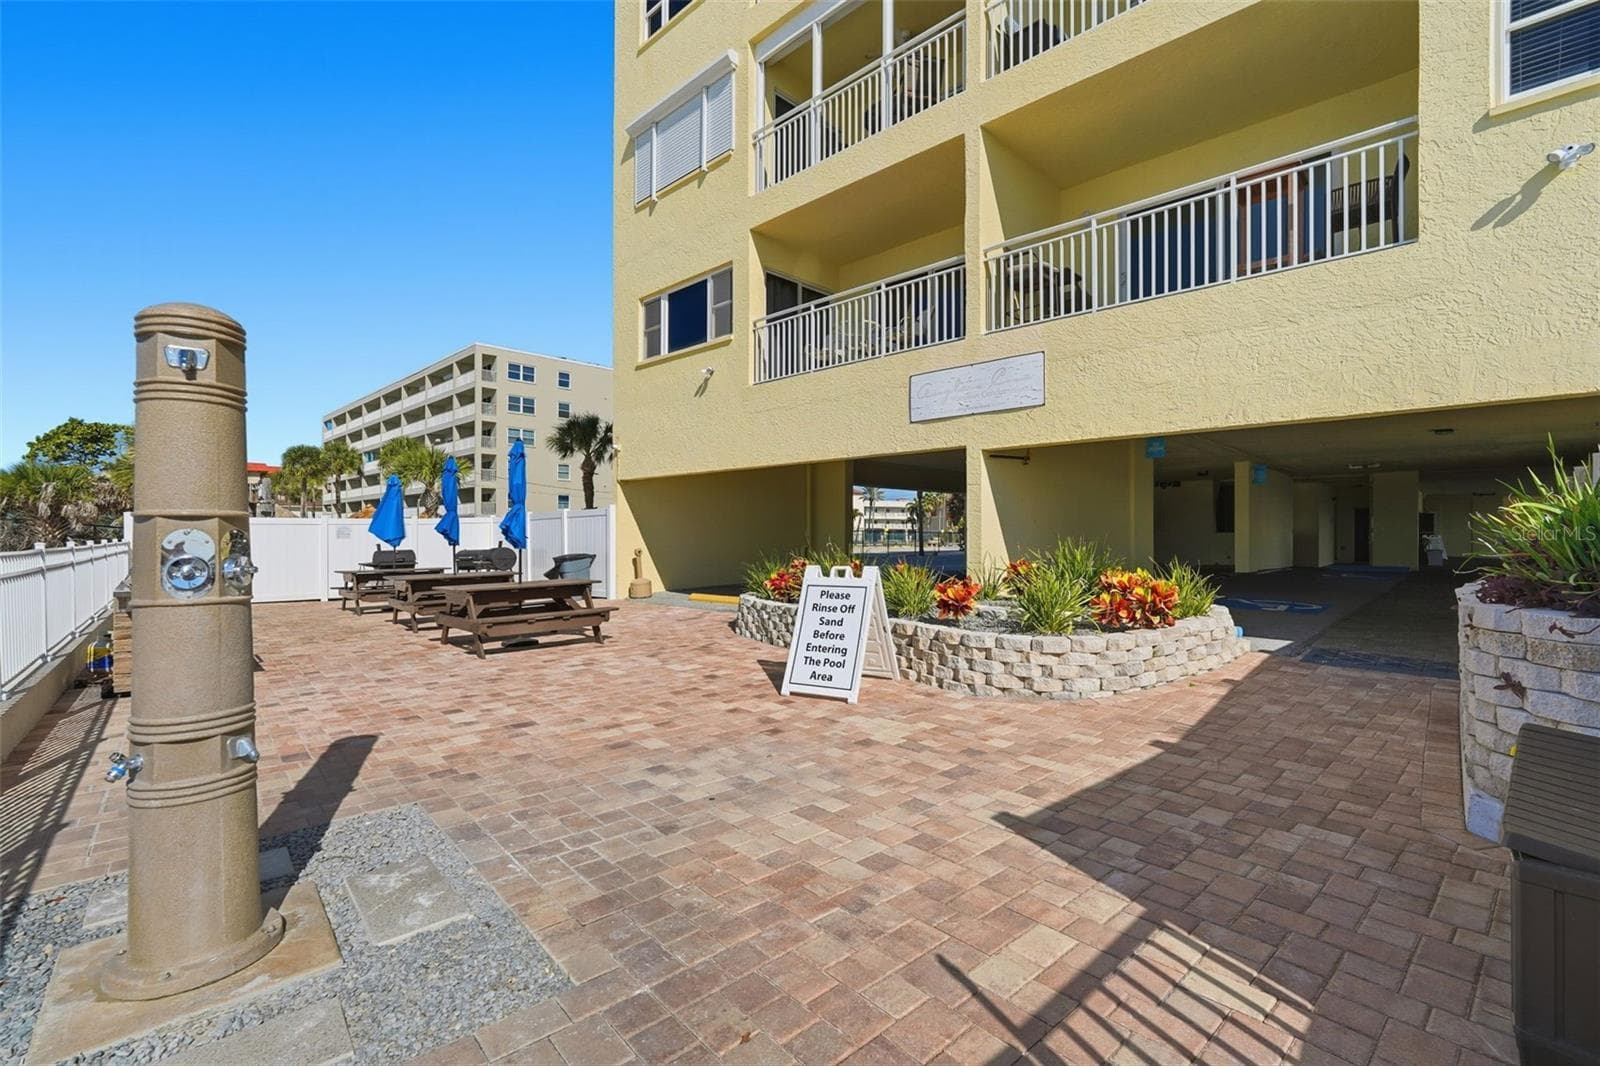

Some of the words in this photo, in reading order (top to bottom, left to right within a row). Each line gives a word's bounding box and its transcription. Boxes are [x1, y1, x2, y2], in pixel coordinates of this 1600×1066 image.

[820, 590, 851, 600] Please
[812, 603, 838, 613] Rinse
[840, 604, 856, 614] Off
[818, 617, 844, 627] Sand
[813, 630, 845, 640] Before
[805, 643, 848, 657] Entering
[803, 656, 821, 667] The
[823, 658, 846, 669] Pool
[809, 671, 833, 682] Area
